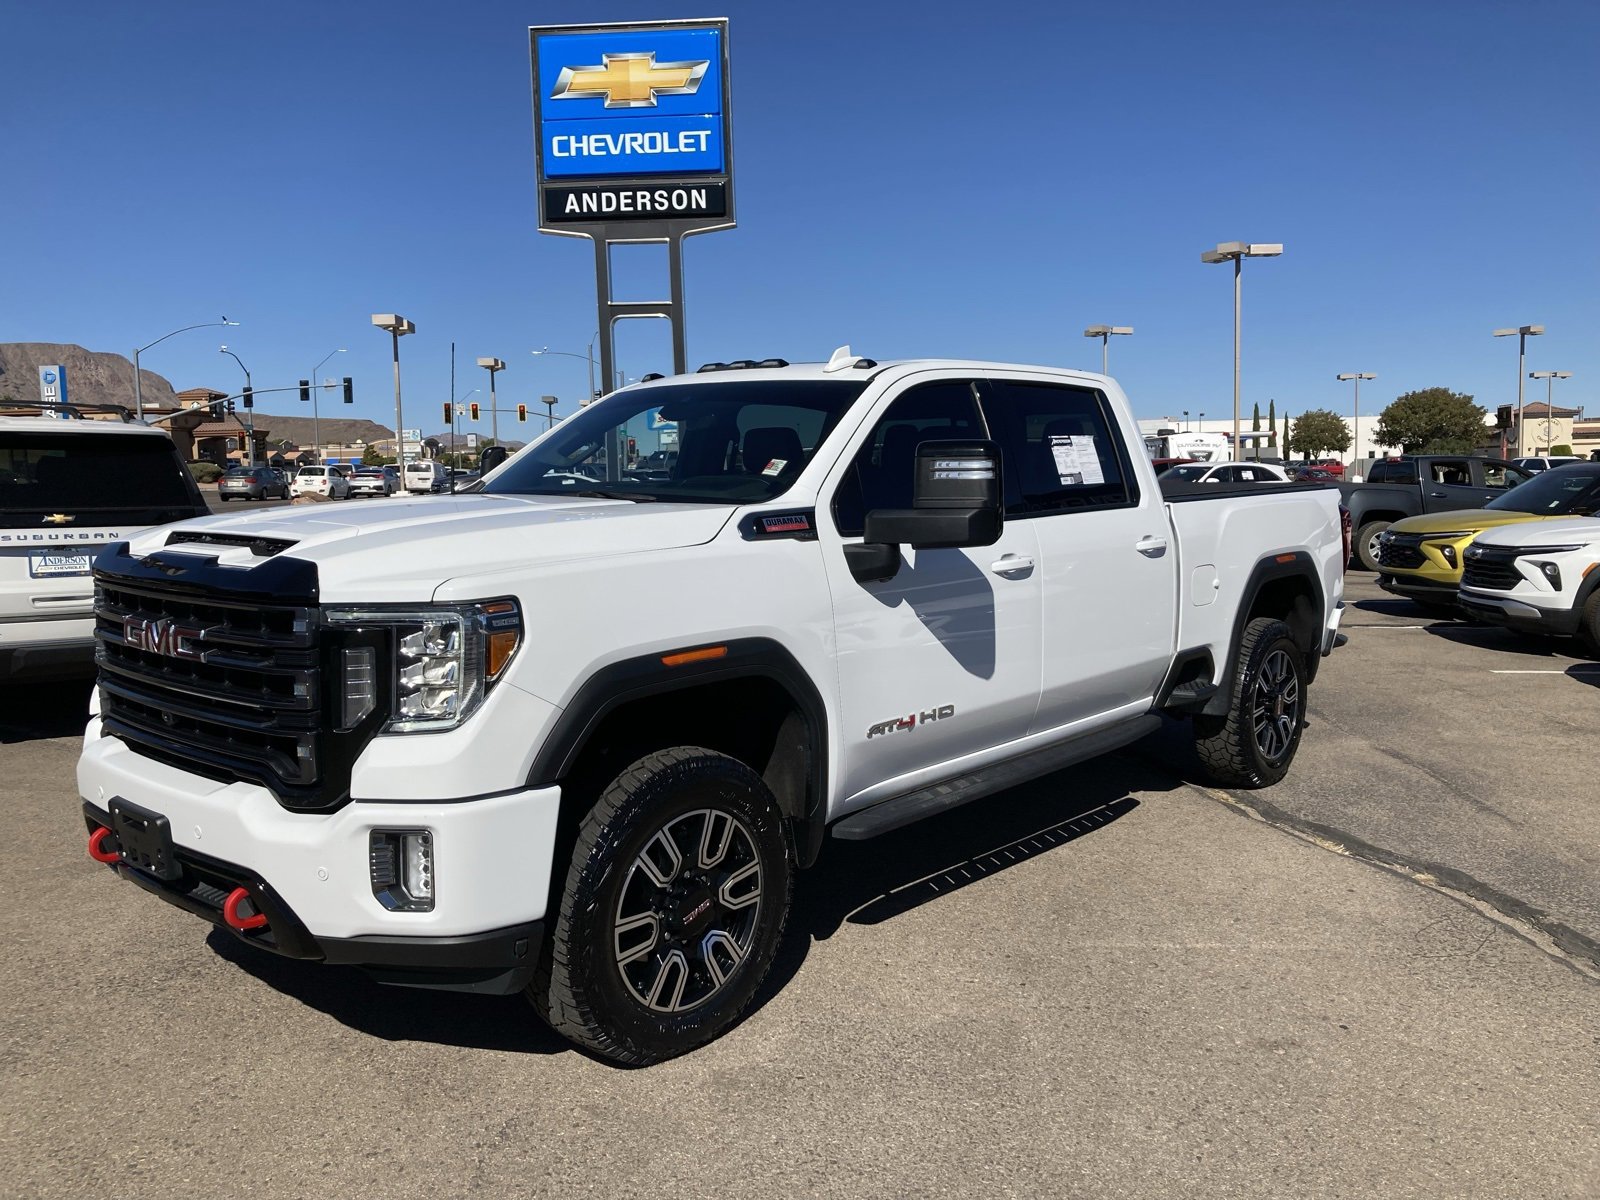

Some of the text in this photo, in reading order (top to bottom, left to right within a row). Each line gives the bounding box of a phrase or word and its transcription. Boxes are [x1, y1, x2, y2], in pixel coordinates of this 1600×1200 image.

[552, 130, 712, 157] CHEVROLET
[564, 188, 707, 213] ANDERSON
[765, 516, 805, 526] DURAMAX
[1, 532, 119, 541] SUBURBAN
[36, 555, 87, 570] ANDERSON
[124, 616, 207, 663] GMC
[866, 704, 954, 739] AT4 HD
